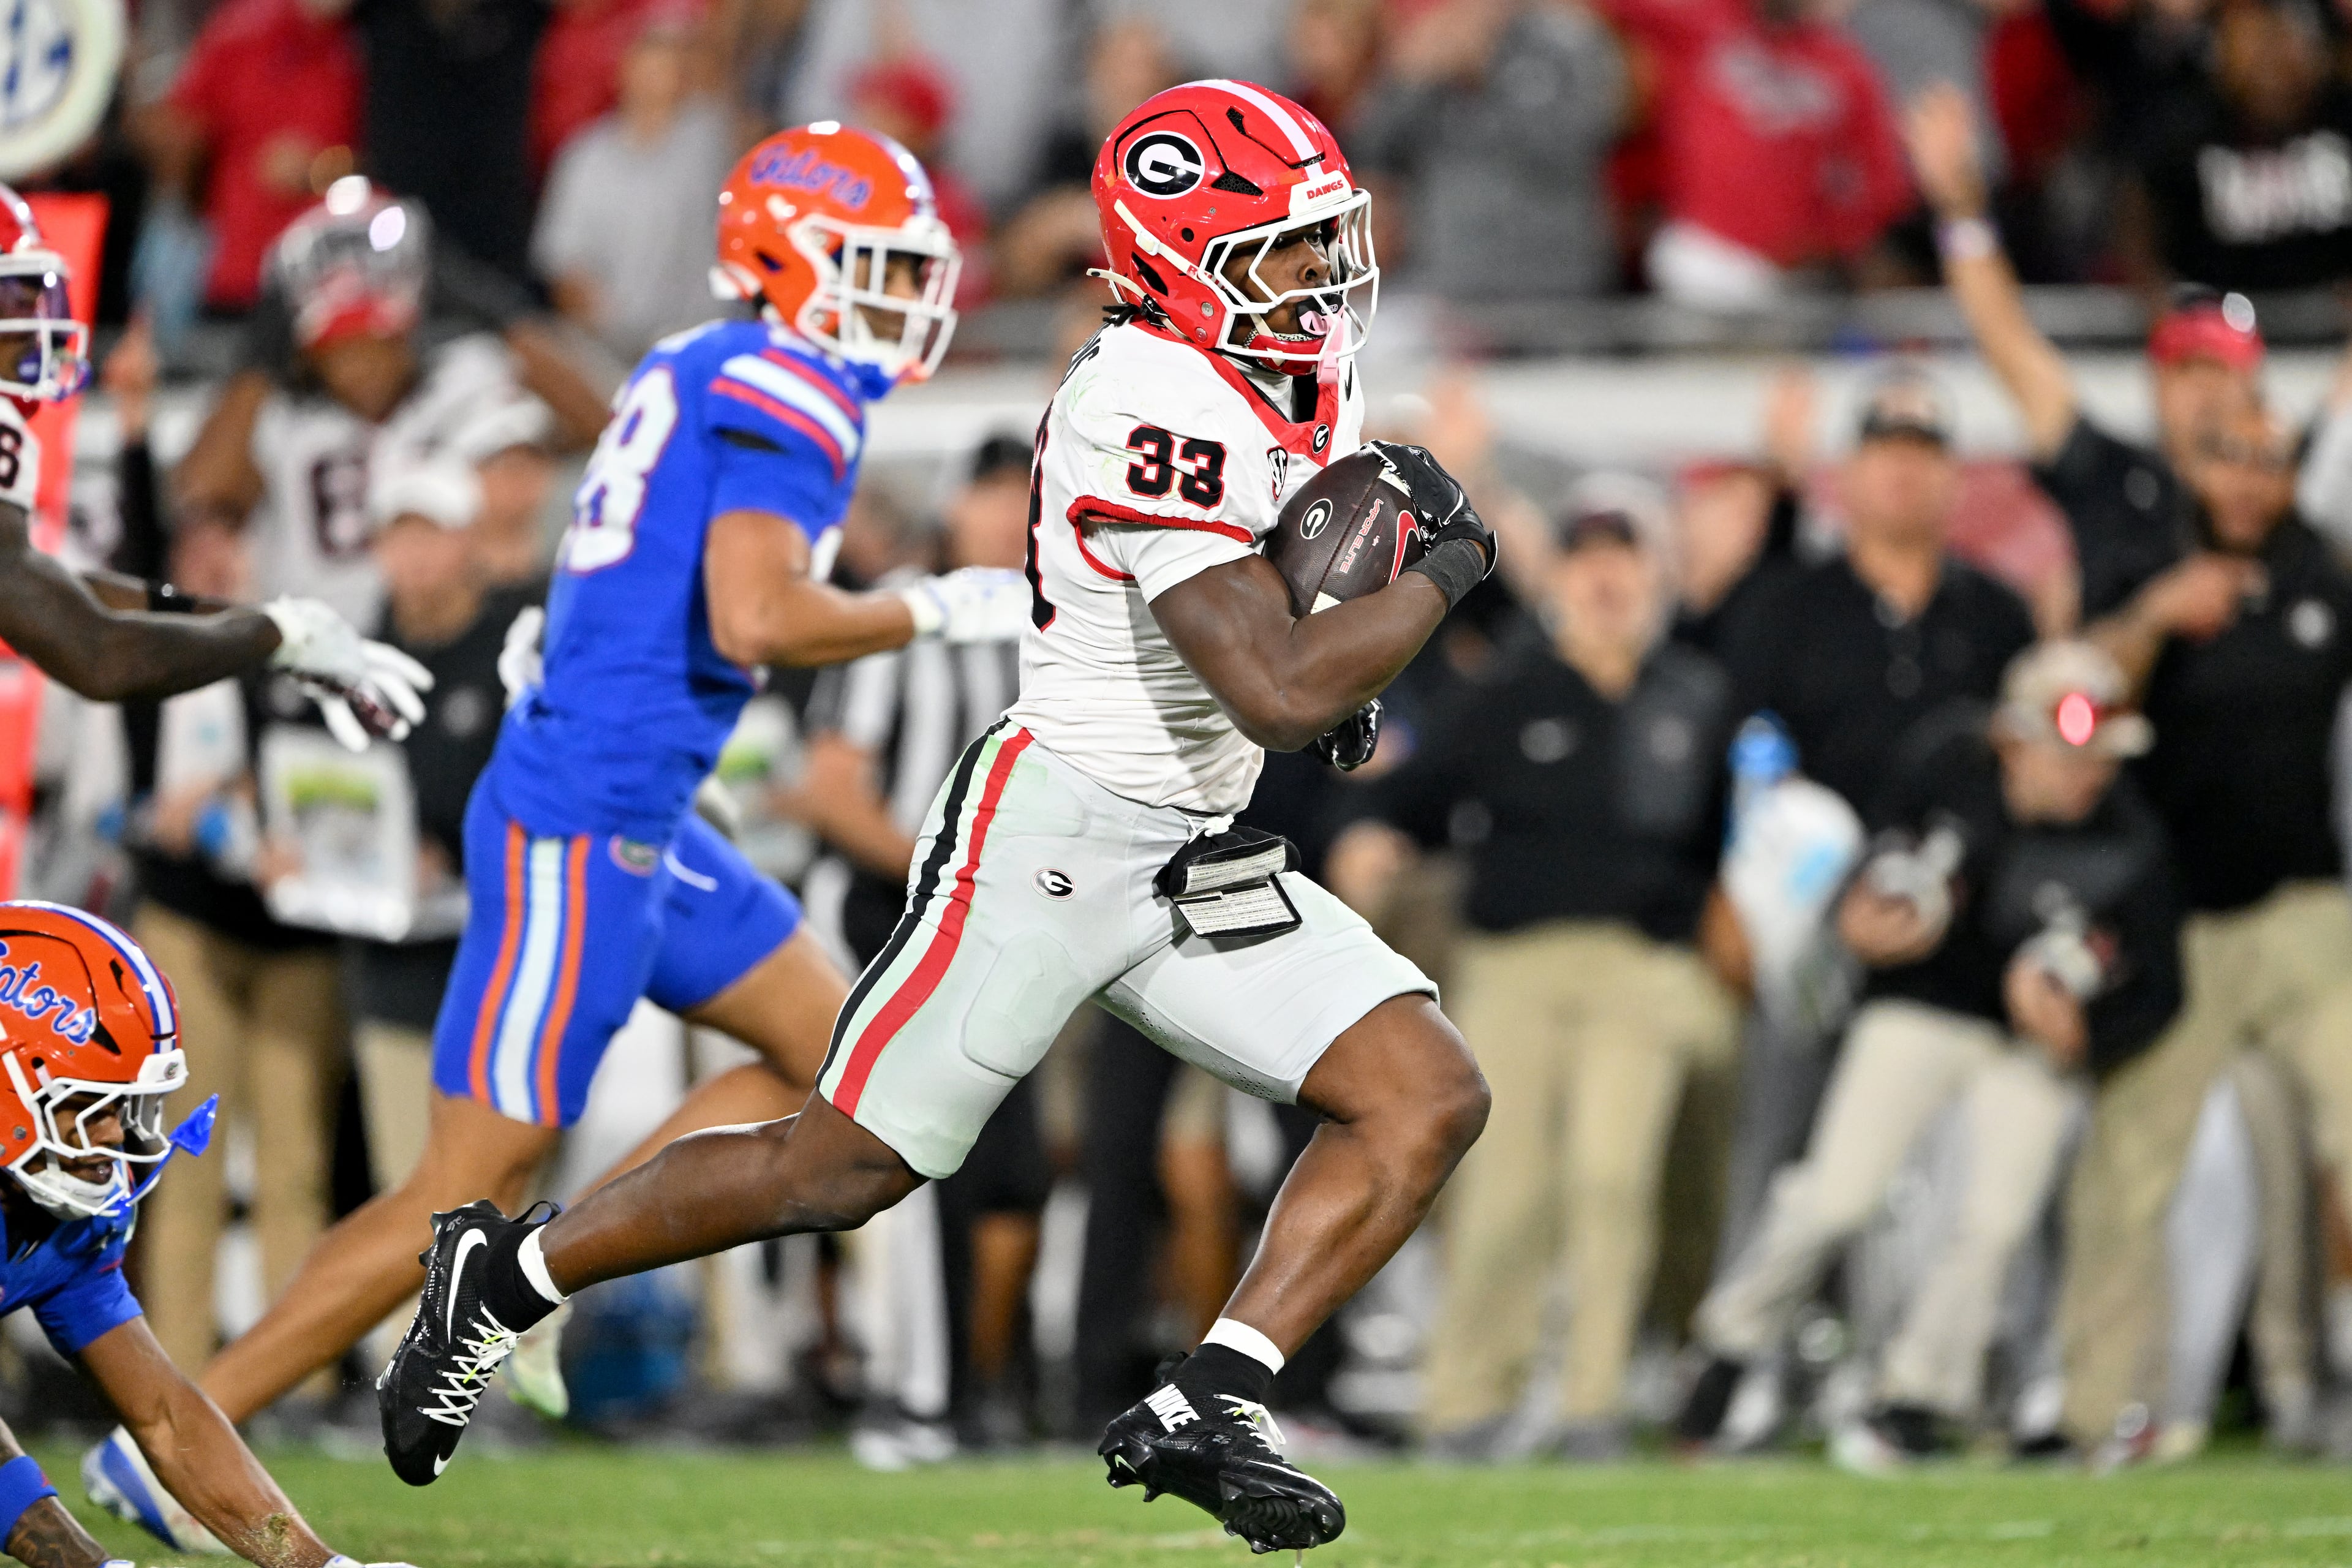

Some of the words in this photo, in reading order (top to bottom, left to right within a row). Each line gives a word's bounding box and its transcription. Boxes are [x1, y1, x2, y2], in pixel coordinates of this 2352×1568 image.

[1125, 133, 1204, 197] G
[1306, 179, 1344, 199] DAWGS
[1313, 424, 1330, 454] G
[1126, 424, 1227, 510] 33
[1359, 498, 1384, 536] VAPOR
[1339, 536, 1365, 573] ELITE
[1035, 870, 1074, 897] G
[0, 940, 97, 1045] ators
[1144, 1383, 1201, 1433] NIKE
